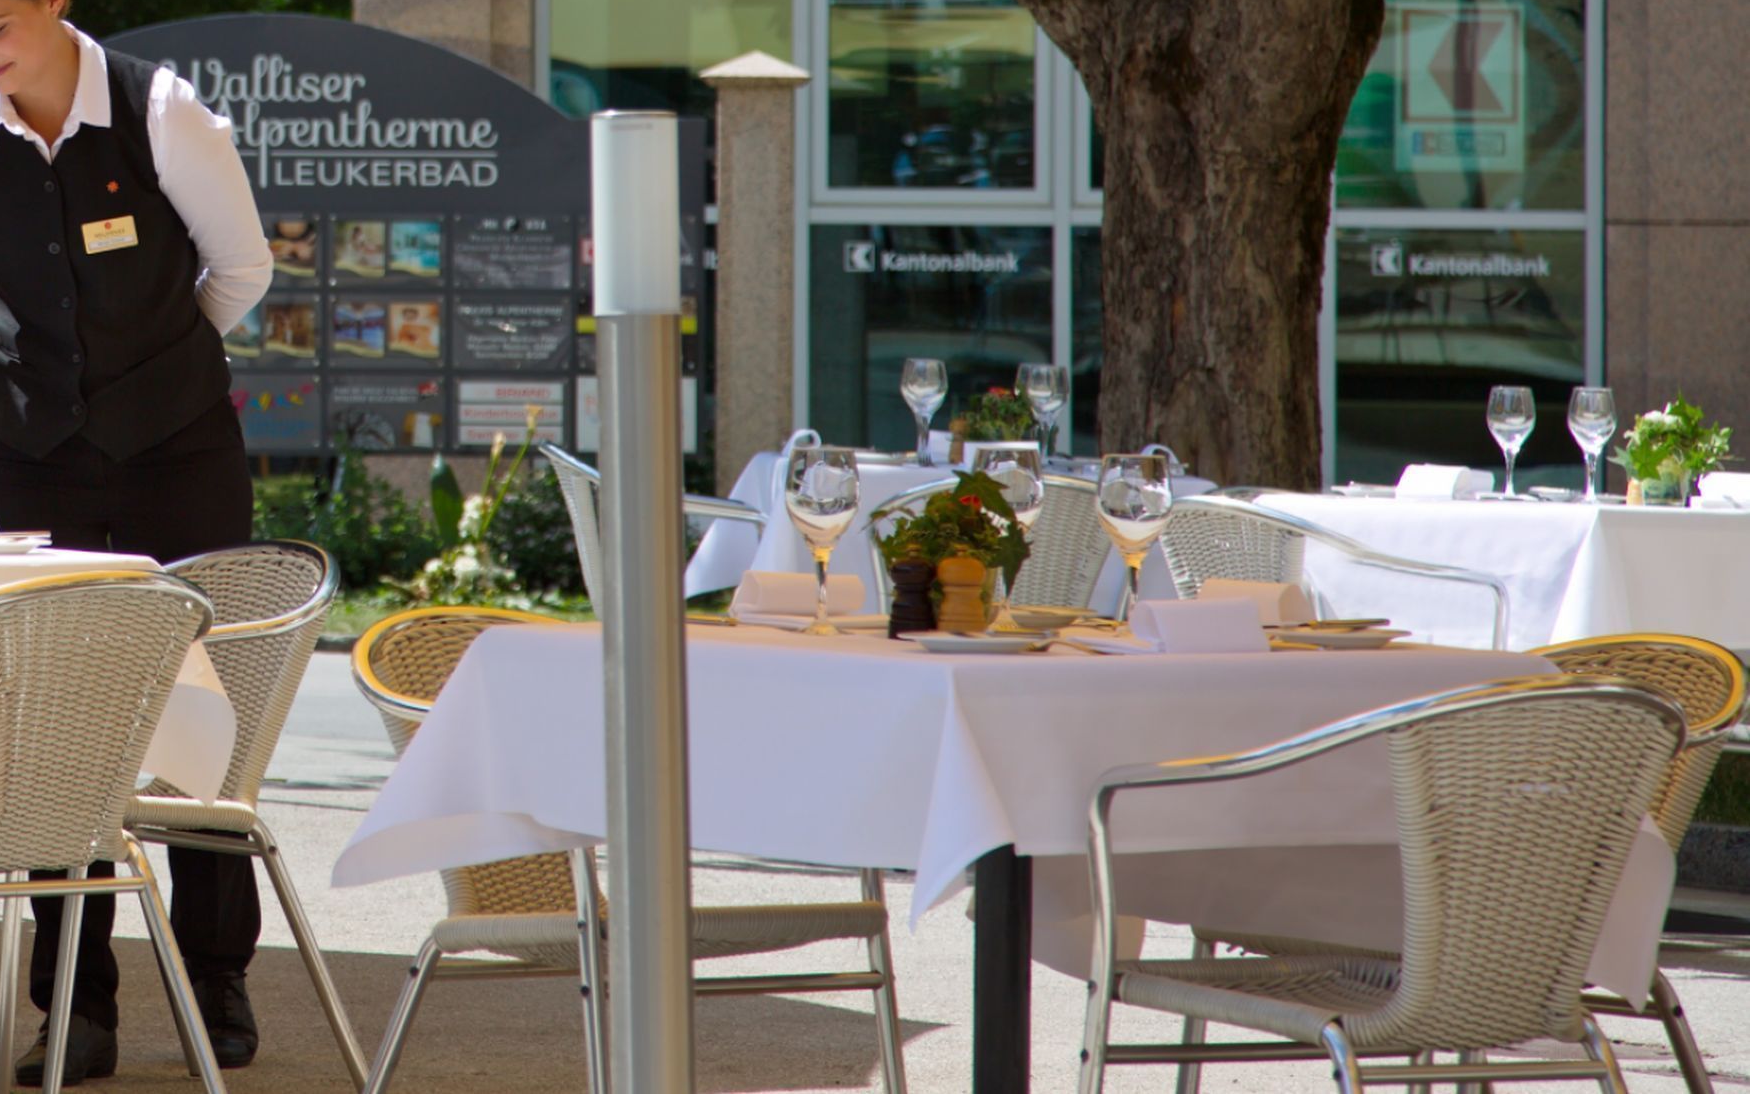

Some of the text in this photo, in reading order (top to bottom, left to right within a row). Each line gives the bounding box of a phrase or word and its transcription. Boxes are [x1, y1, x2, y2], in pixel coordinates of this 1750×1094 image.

[159, 55, 366, 104] Walliser
[274, 159, 498, 187] LEUKERBAD
[881, 250, 1020, 273] Kantonalbank
[1409, 253, 1550, 277] Kantonalbank
